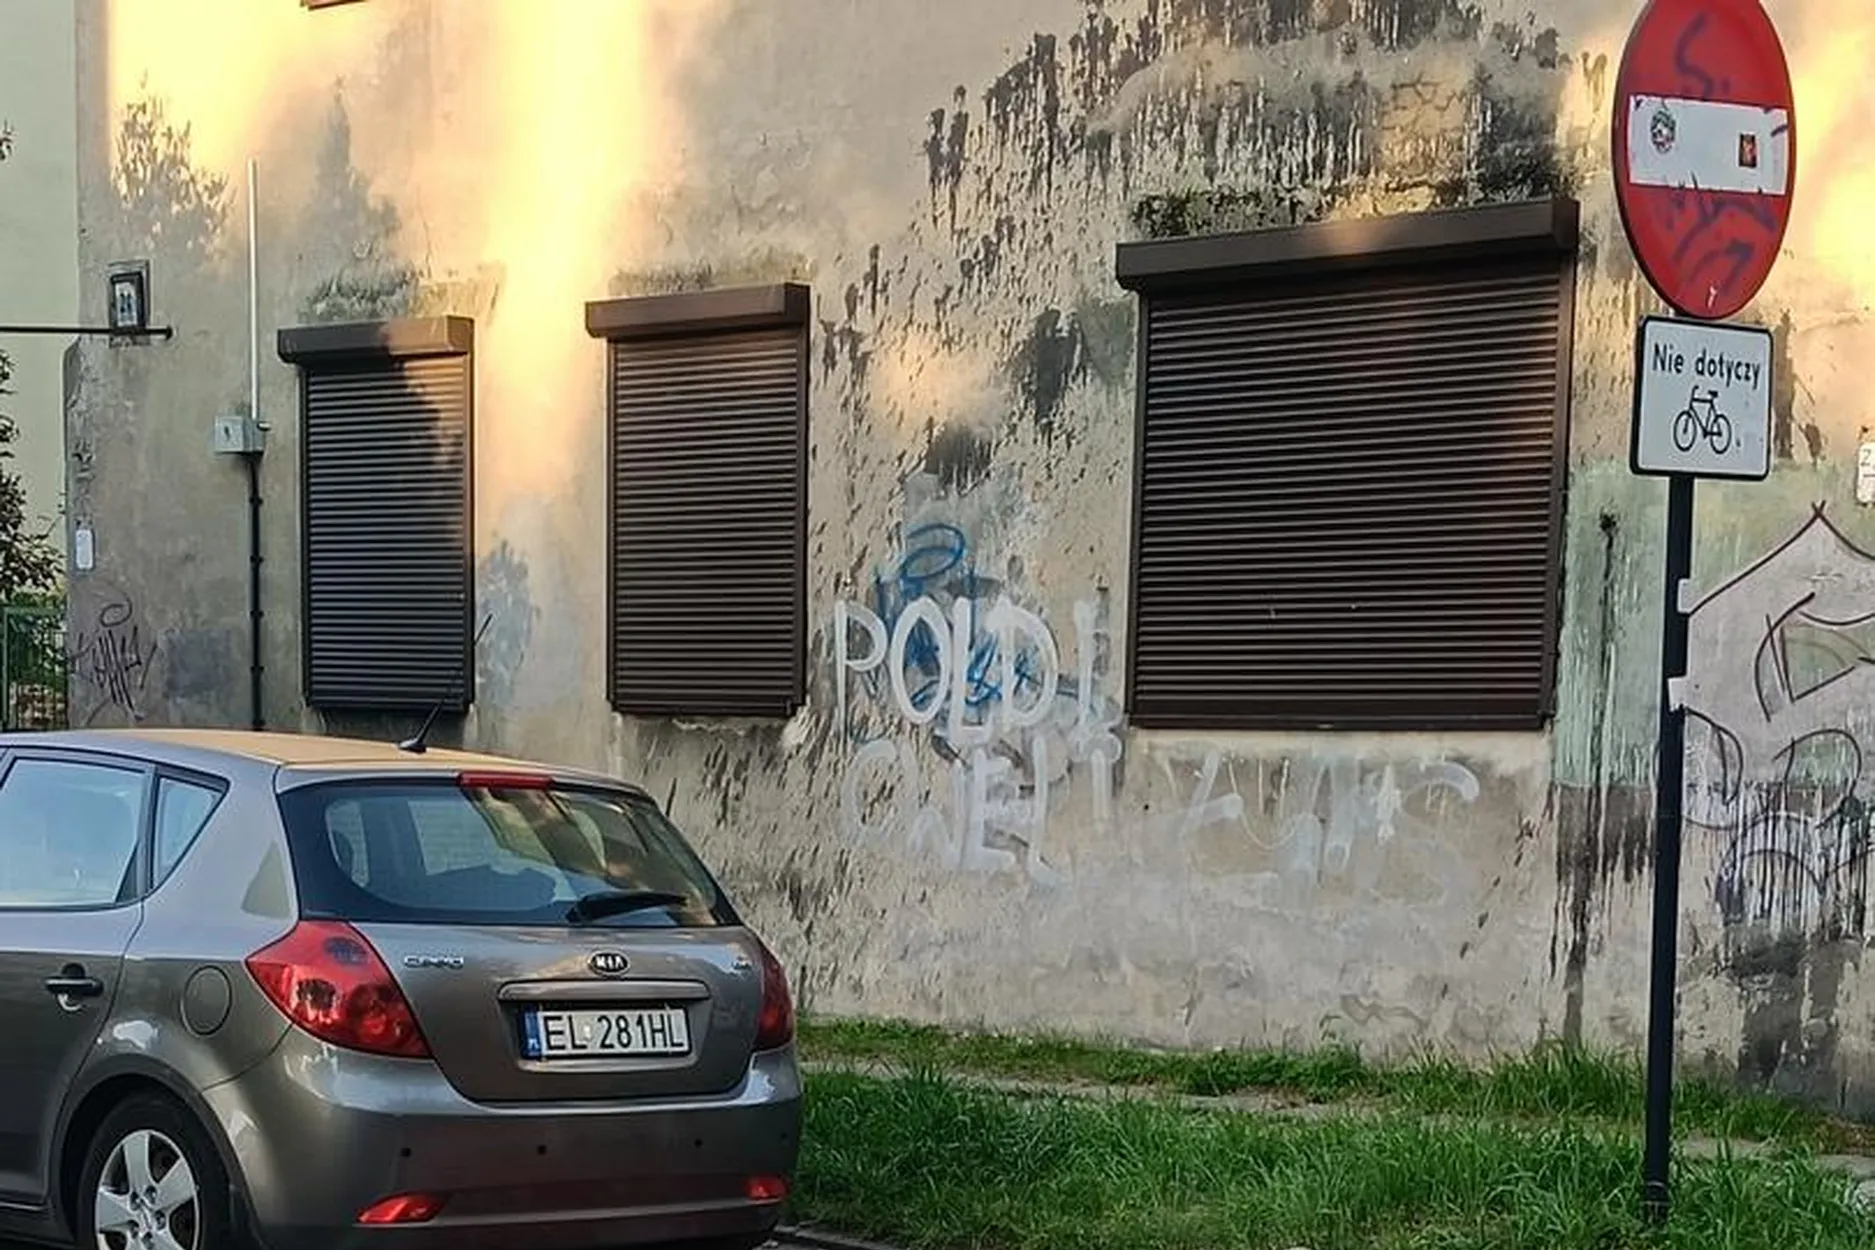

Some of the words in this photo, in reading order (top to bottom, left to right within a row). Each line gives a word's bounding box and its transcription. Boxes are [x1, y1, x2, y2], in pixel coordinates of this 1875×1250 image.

[1652, 342, 1684, 374] Nie
[1695, 347, 1760, 390] dotyczy
[596, 955, 624, 969] KIA
[542, 1015, 588, 1050] EL
[597, 1013, 684, 1050] 281HL
